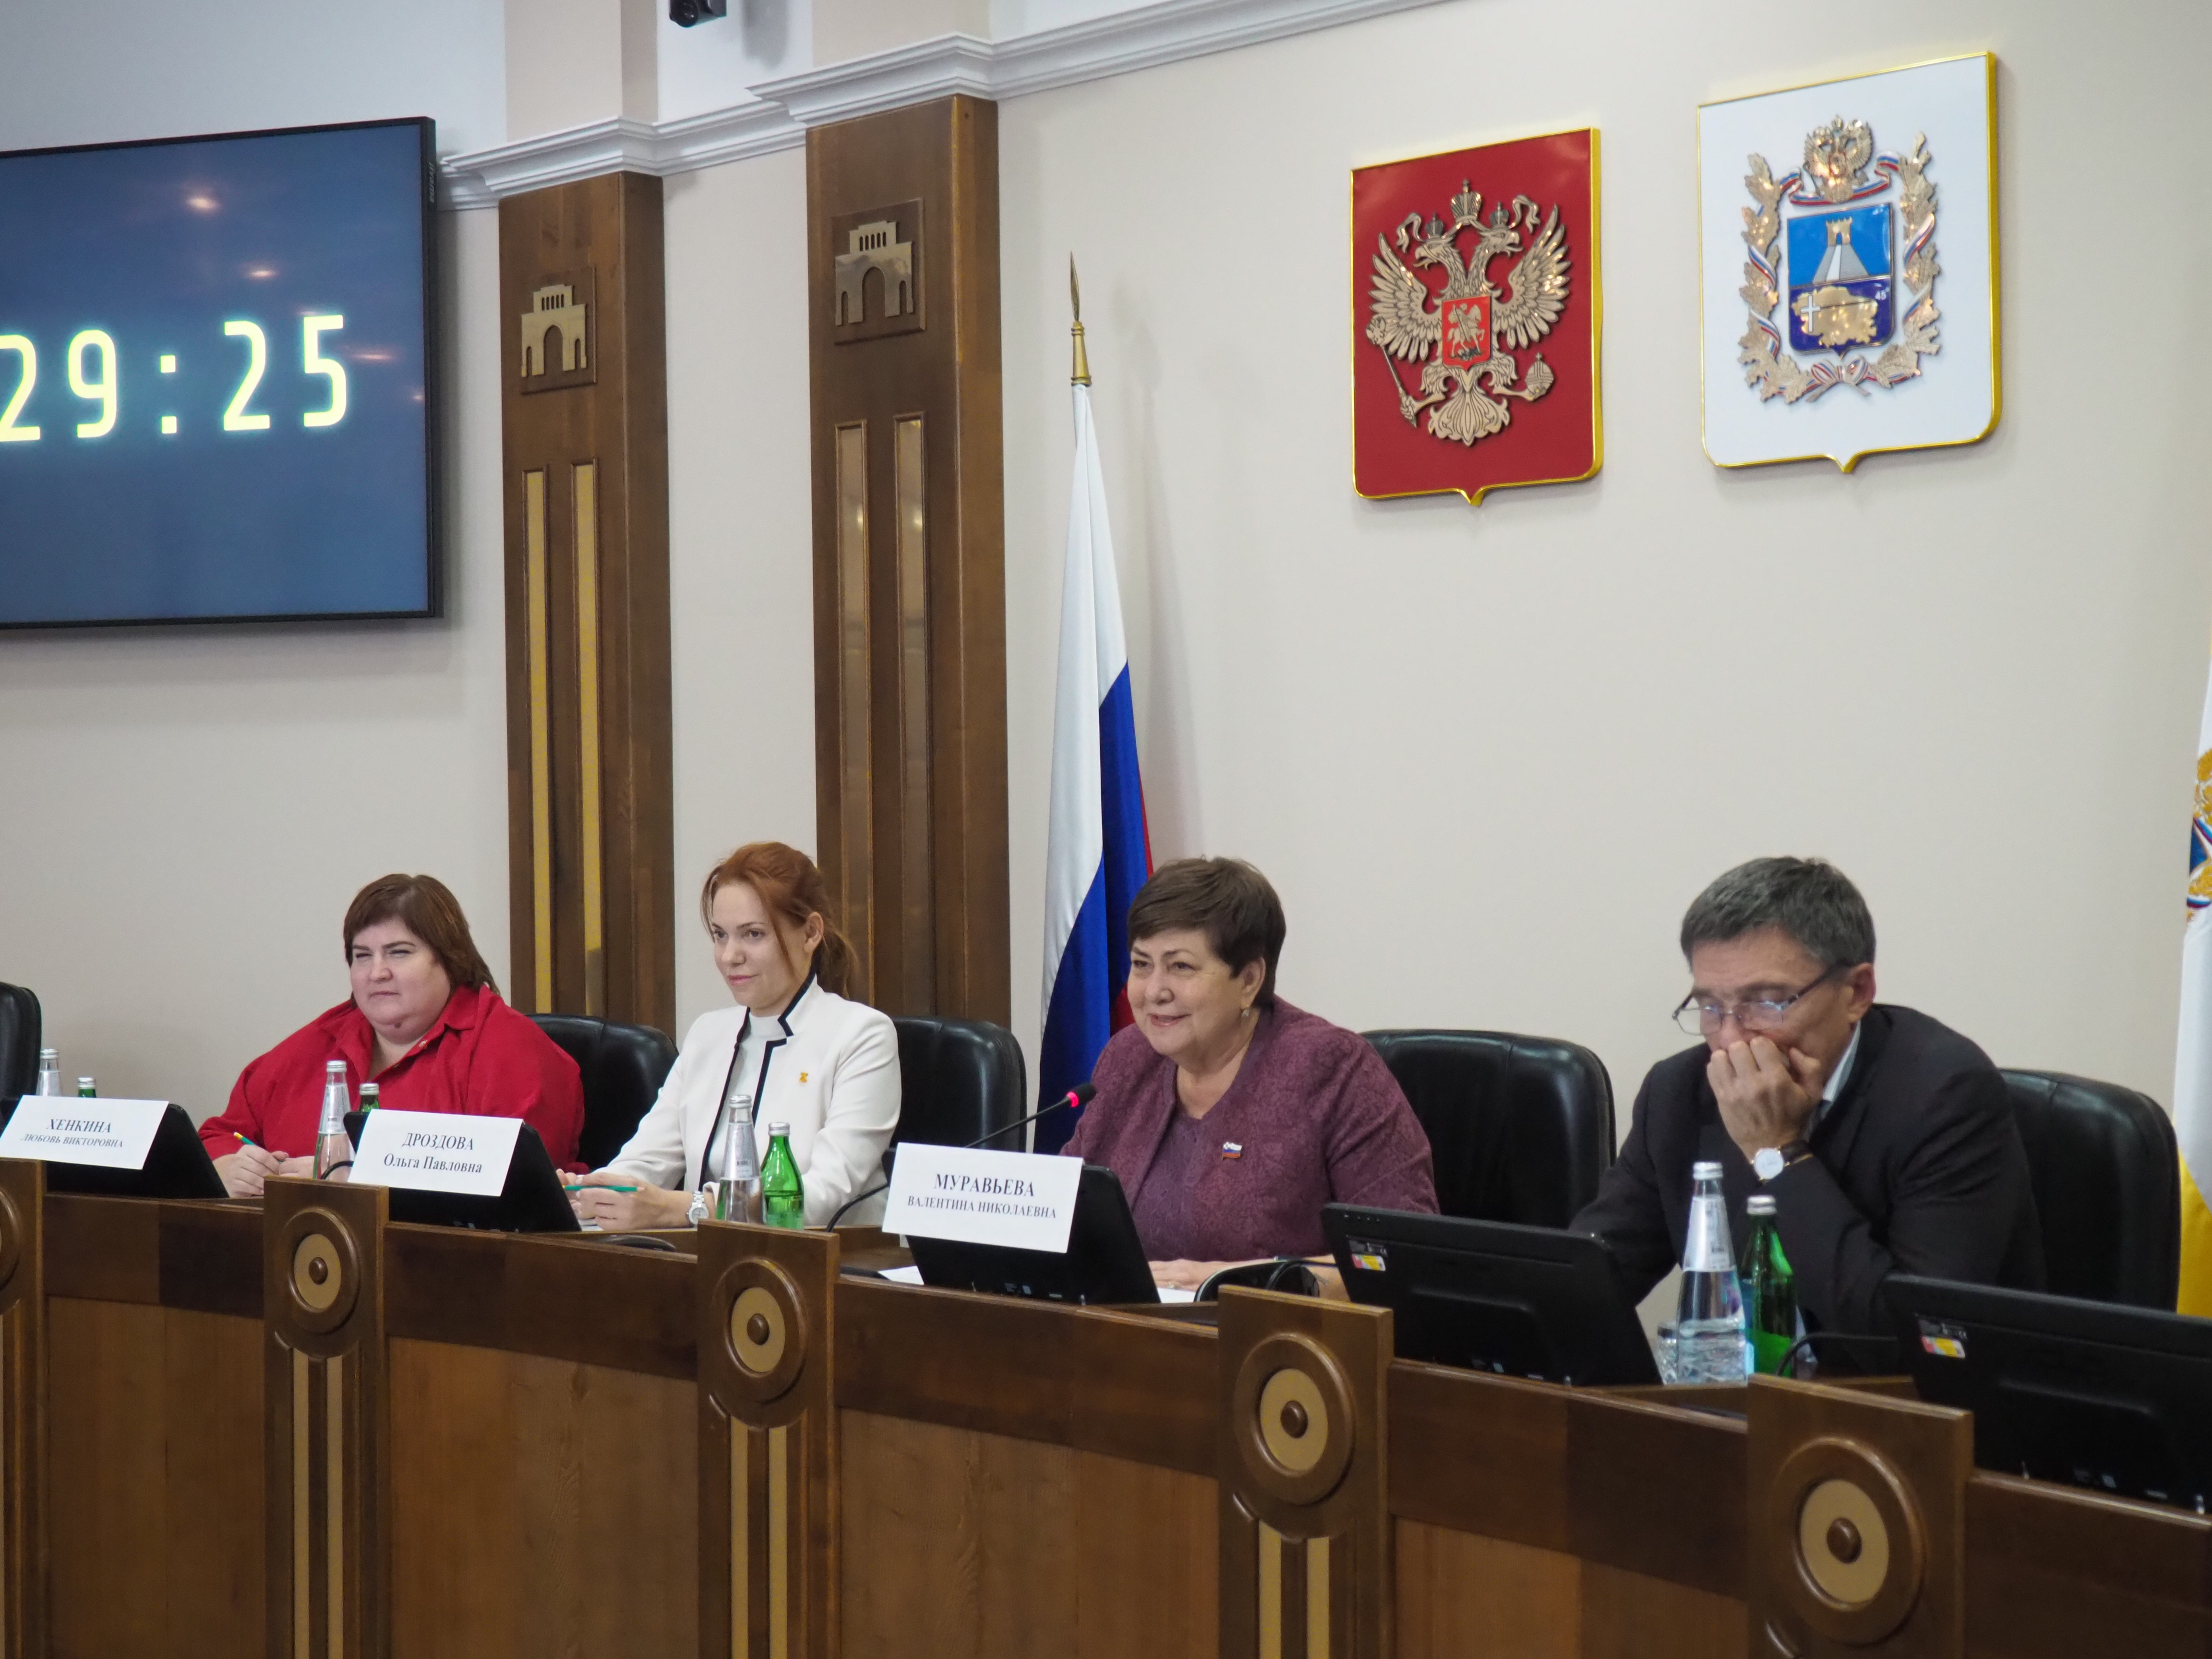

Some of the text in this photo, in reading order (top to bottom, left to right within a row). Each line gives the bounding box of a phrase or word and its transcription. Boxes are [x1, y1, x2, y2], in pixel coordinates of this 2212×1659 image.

[47, 1119, 111, 1133] ХЕНКИНА
[21, 1134, 123, 1148] ЛЮБОВЬ ВИКТОРОВНА
[401, 1132, 474, 1151] ДРОЗДОВА
[384, 1153, 482, 1173] Ольга Павловна
[934, 1174, 1034, 1197] МУРАВЬЕВА
[908, 1196, 1057, 1219] ВАЛЕНТИНА НИКОЛАЕВНА
